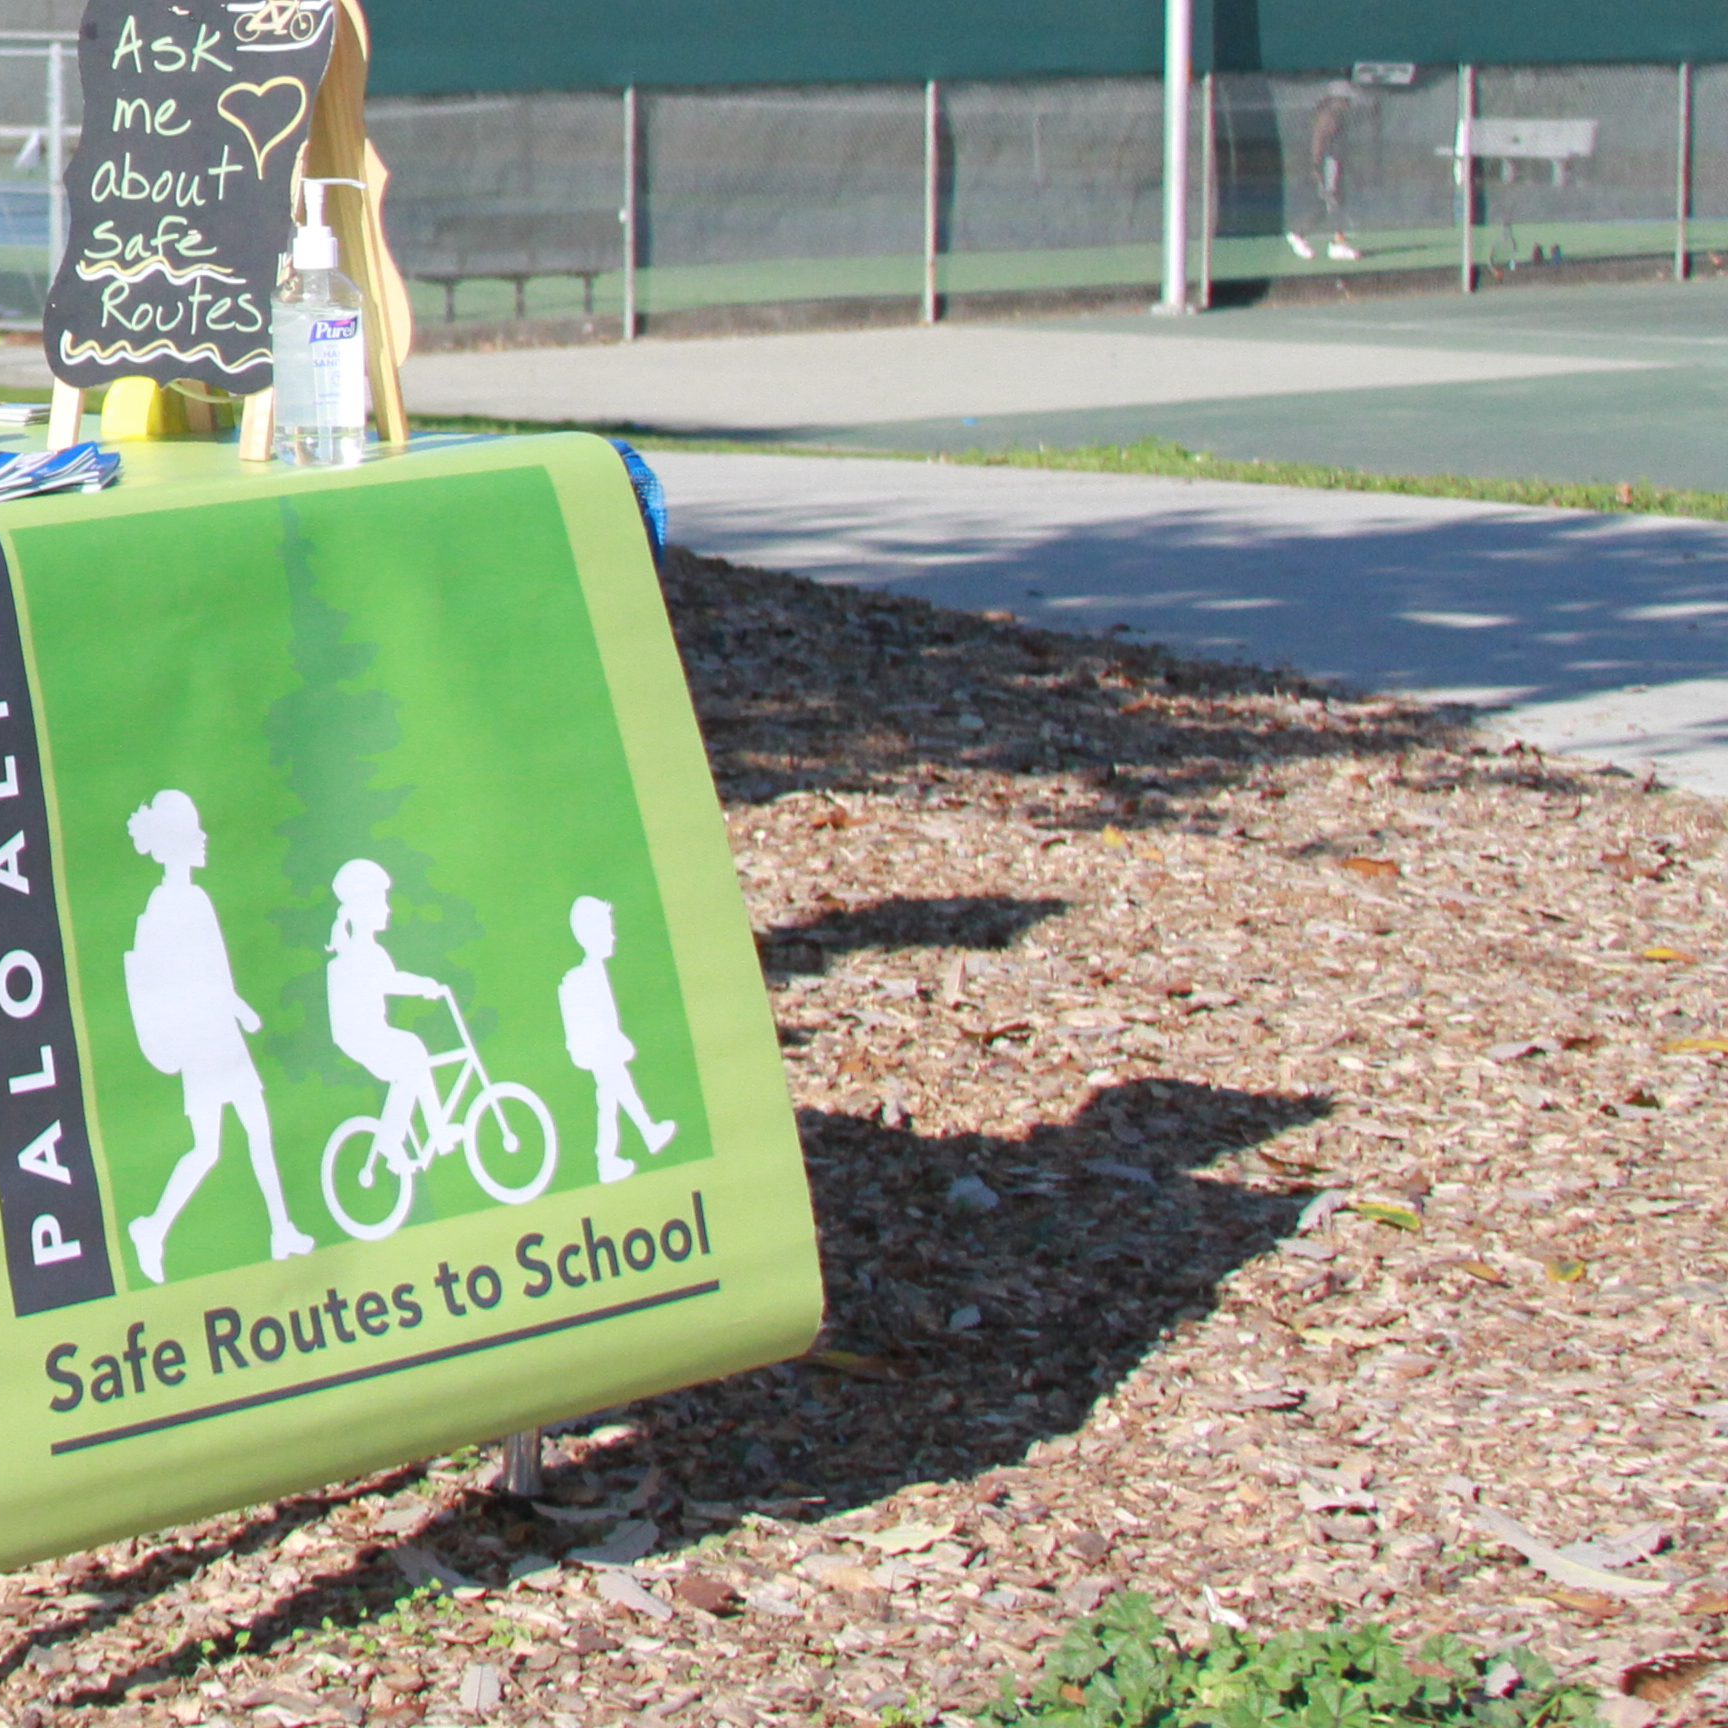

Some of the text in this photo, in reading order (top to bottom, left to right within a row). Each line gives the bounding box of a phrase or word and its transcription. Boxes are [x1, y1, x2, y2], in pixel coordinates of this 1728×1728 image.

[112, 15, 233, 73] Ask
[112, 96, 192, 136] me
[91, 145, 243, 207] about
[84, 216, 217, 261] Safe
[315, 321, 356, 339] Purell
[44, 1190, 711, 1412] Safe Routes to School
